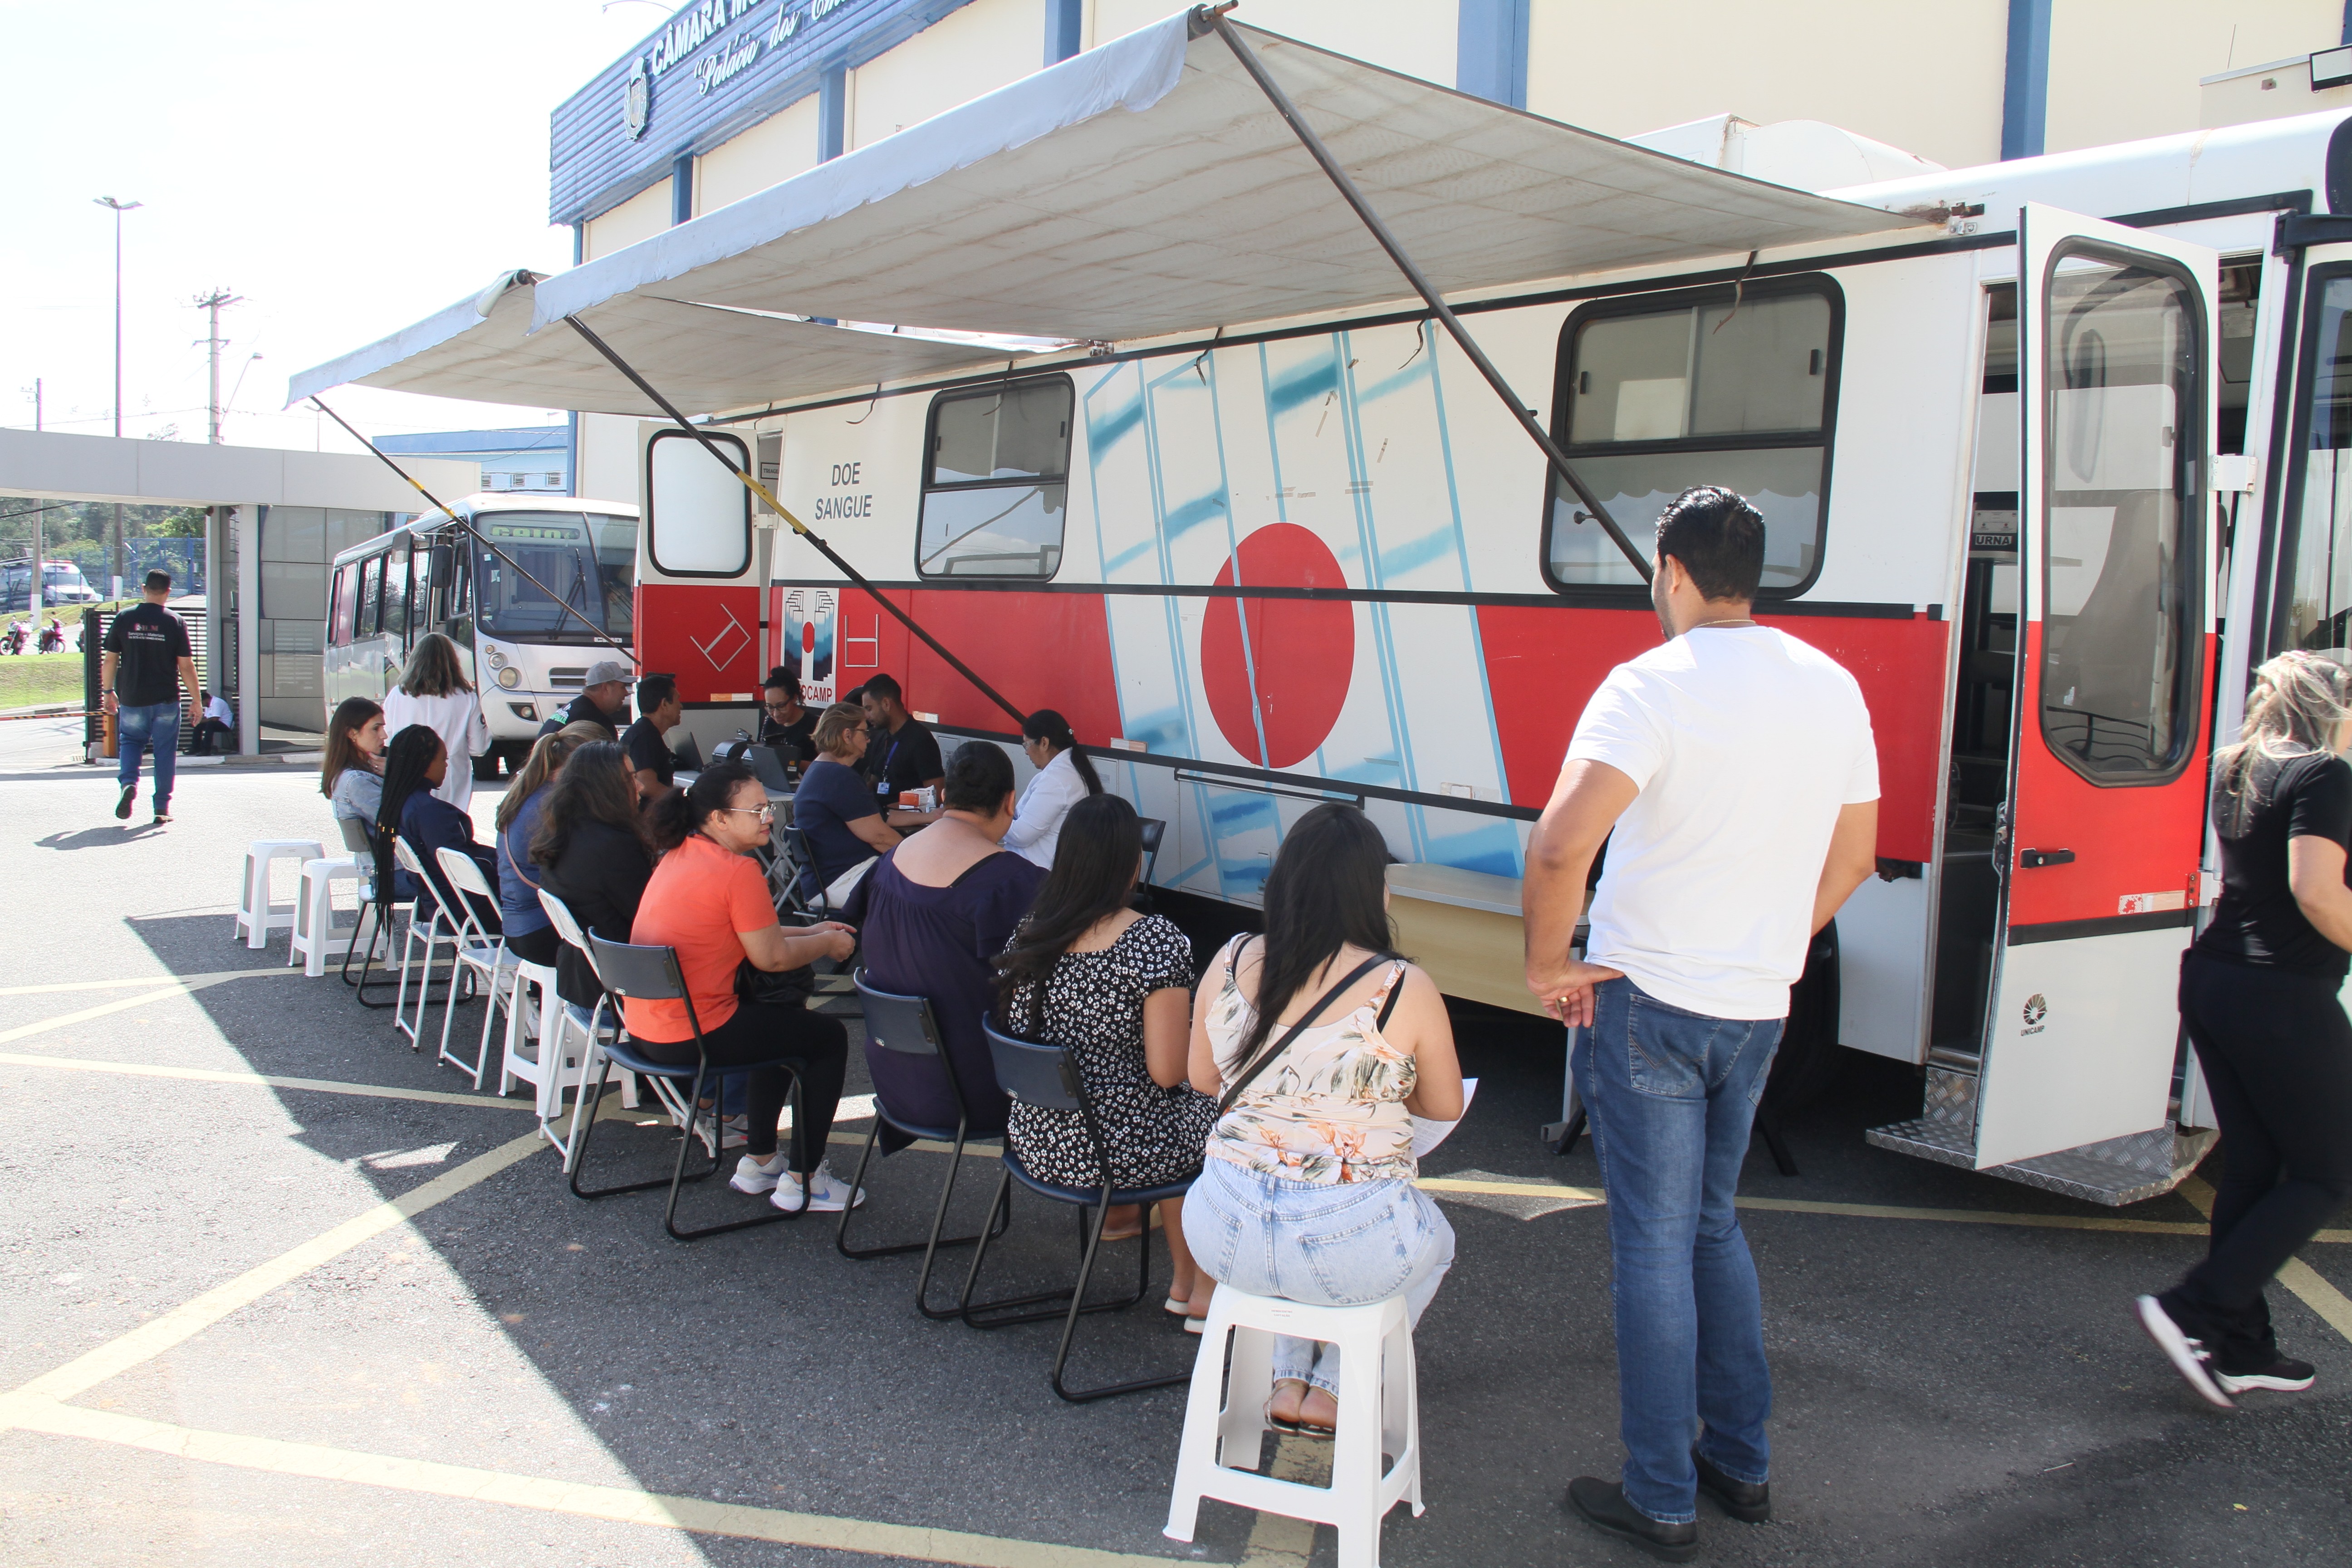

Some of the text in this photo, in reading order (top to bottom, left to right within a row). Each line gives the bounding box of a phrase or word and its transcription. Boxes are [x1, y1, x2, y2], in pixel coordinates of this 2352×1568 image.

[652, 0, 726, 76] CÂMARA
[769, 3, 800, 49] dos
[832, 462, 861, 486] DOE
[815, 495, 872, 520] SANGUE
[1976, 536, 2010, 545] URNA
[800, 685, 833, 703] OCAMP
[2021, 1025, 2045, 1036] UNICAMP
